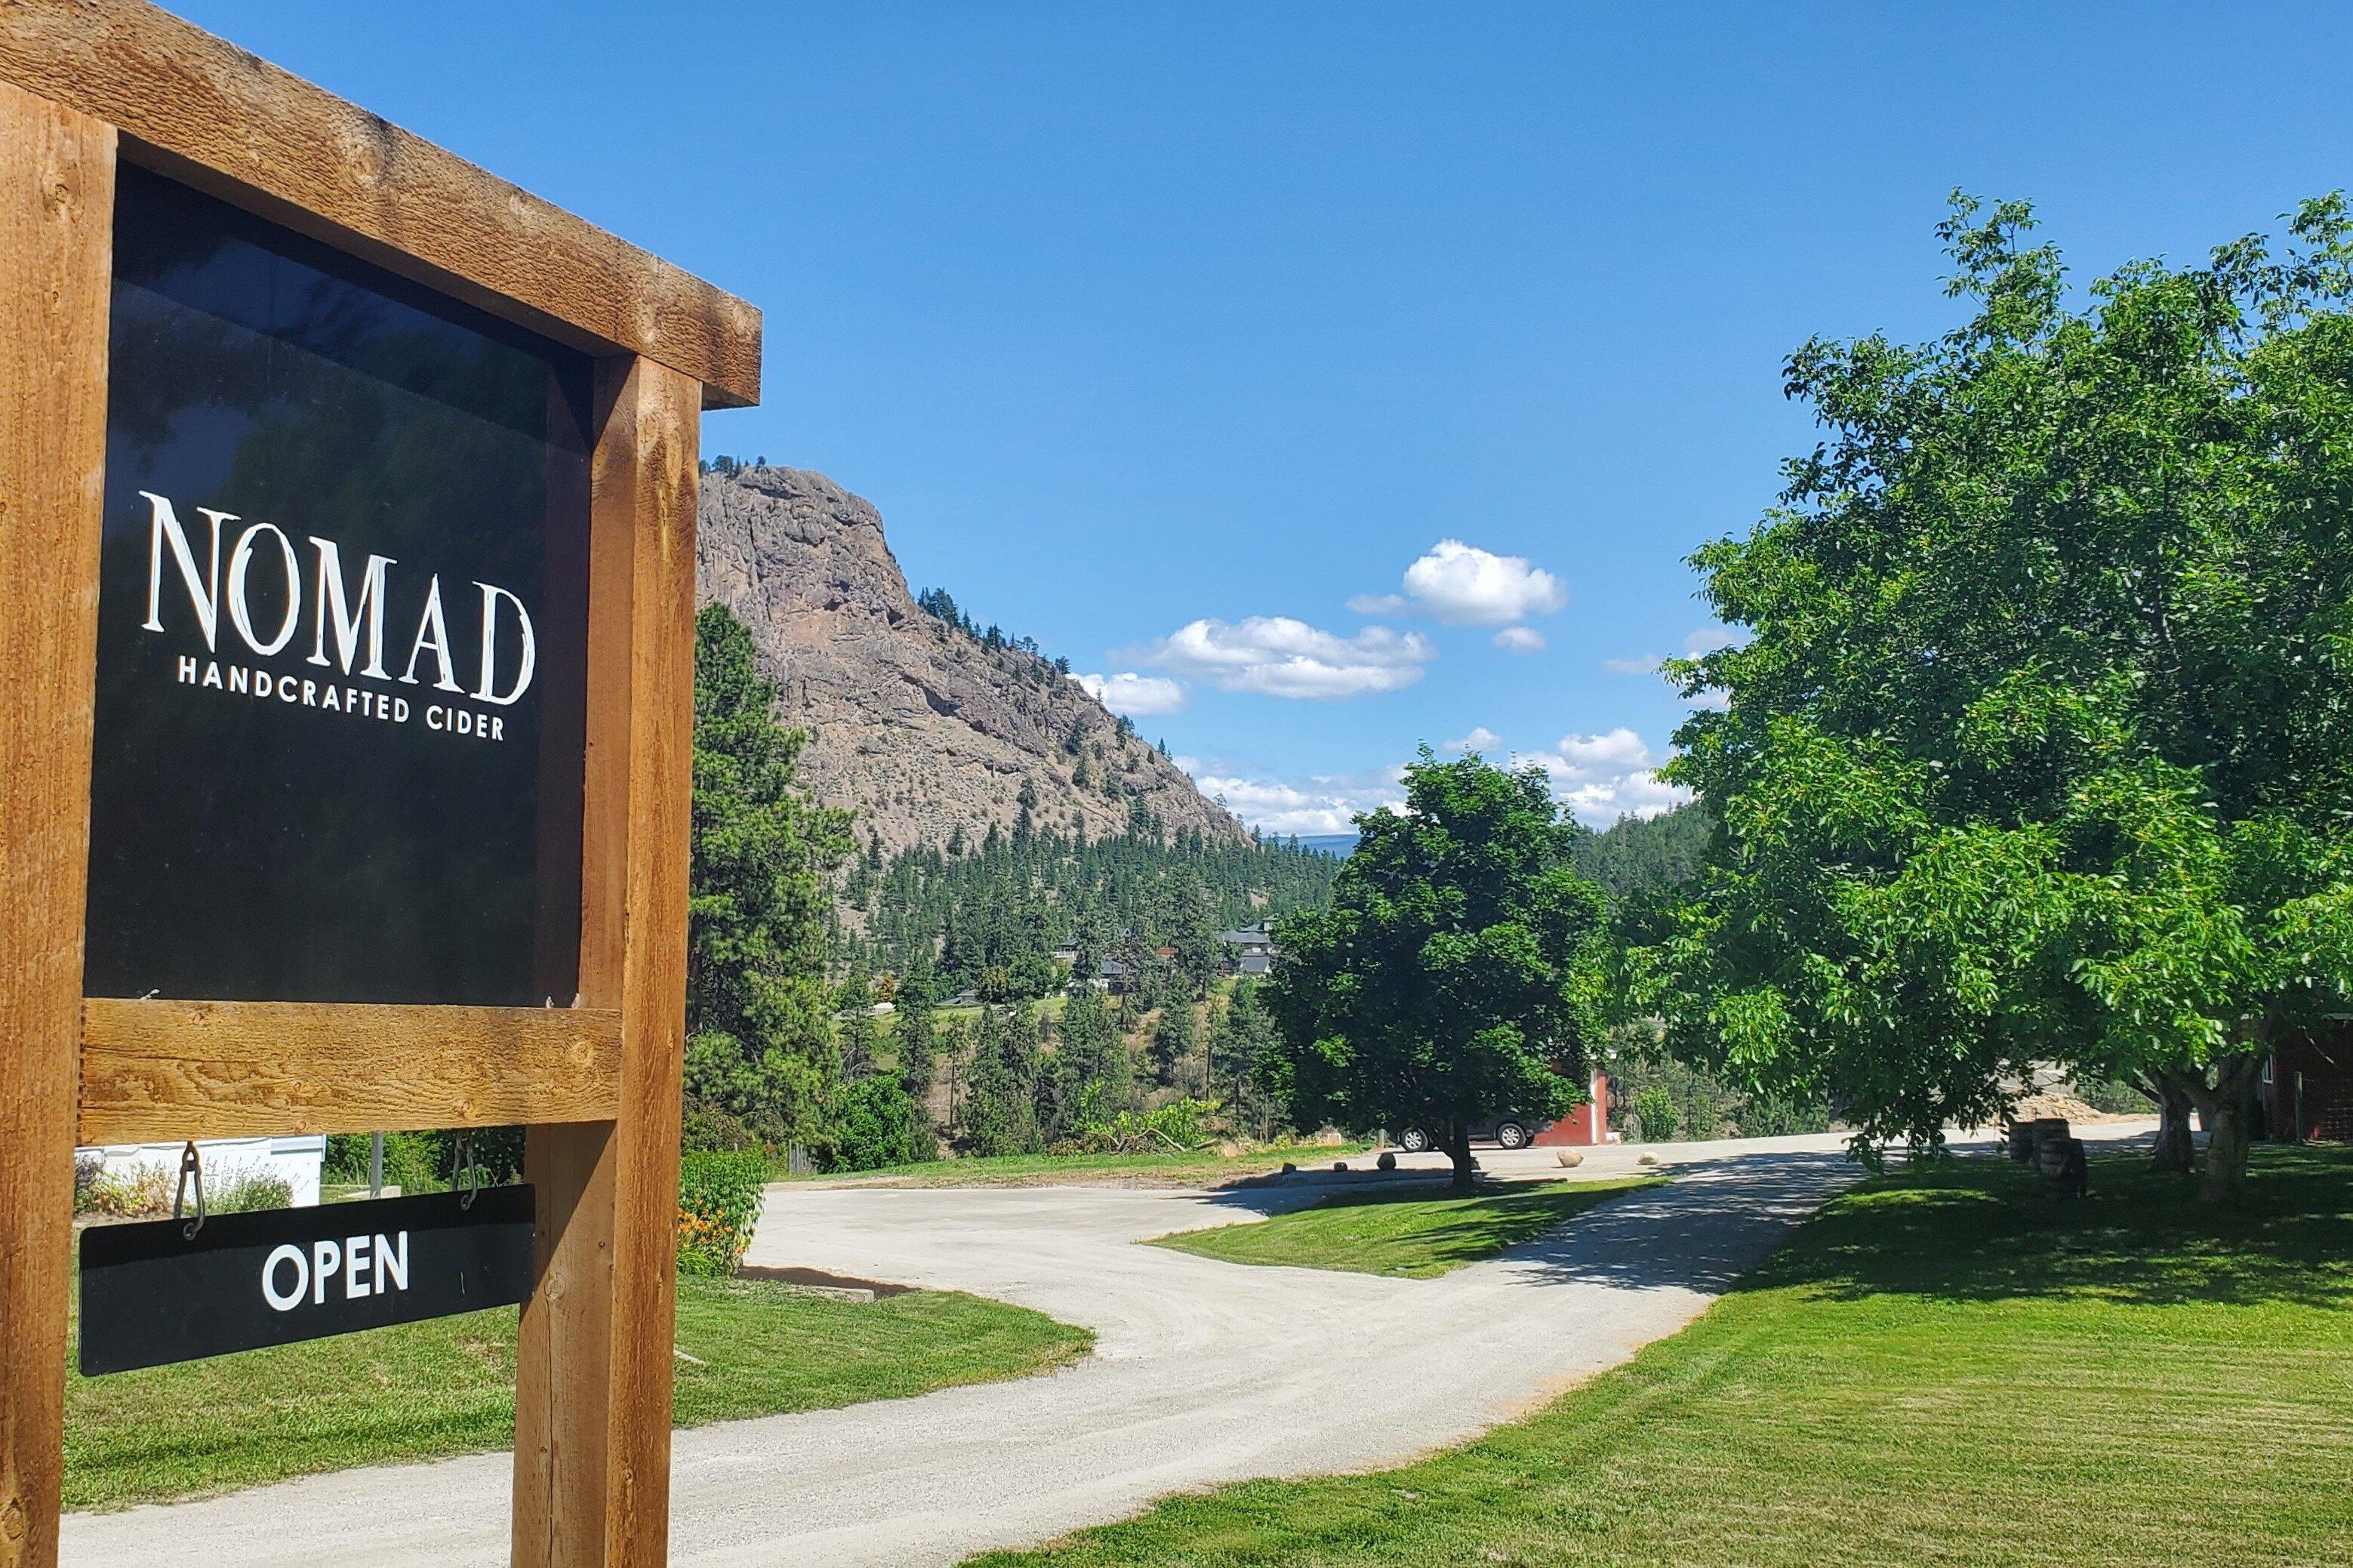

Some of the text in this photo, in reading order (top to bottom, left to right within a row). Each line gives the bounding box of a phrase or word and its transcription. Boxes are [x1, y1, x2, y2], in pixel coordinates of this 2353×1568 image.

[139, 490, 535, 706] NOMAD
[178, 655, 504, 741] HANDCRAFTED CIDER
[262, 1231, 408, 1311] OPEN
